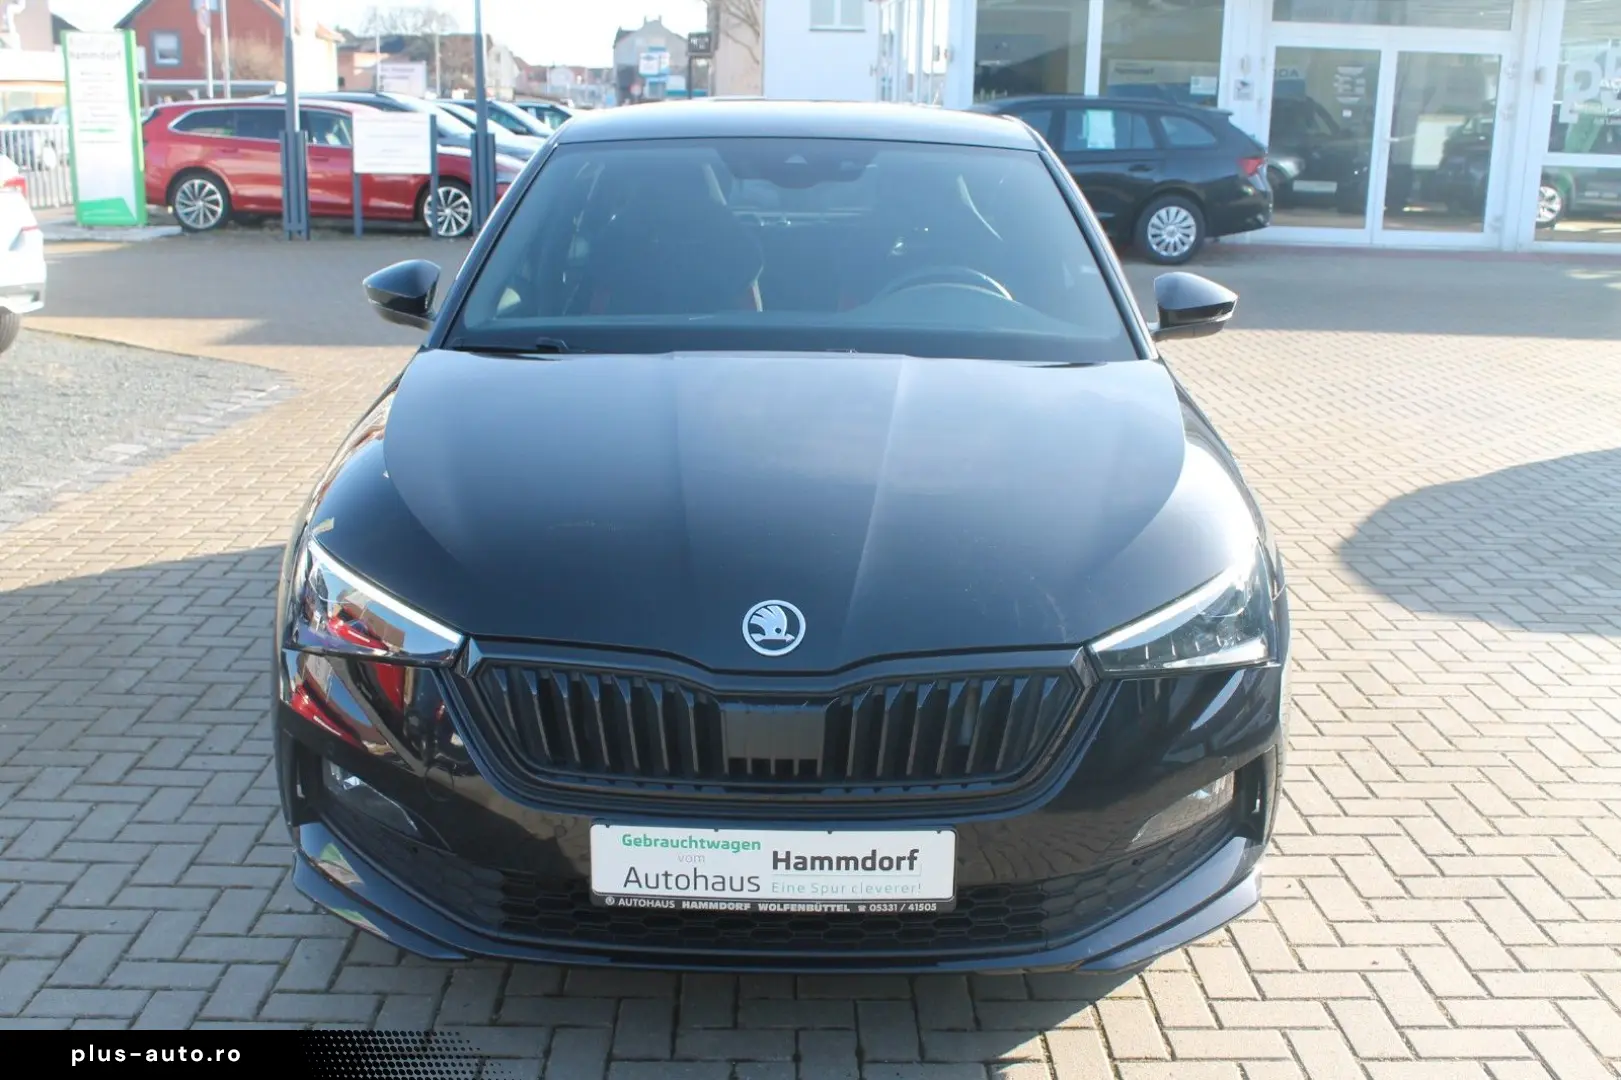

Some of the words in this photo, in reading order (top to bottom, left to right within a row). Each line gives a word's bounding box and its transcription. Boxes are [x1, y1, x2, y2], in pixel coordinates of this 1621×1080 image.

[621, 833, 762, 853] Gebrauchtwagen
[677, 853, 705, 863] vom
[772, 848, 920, 871] Hammdorf
[623, 866, 761, 892] Autohaus
[771, 881, 806, 893] Eine
[811, 882, 845, 896] Spur
[851, 881, 921, 894] cleverer!
[618, 897, 675, 908] AUTOHAUS
[682, 901, 751, 912] HAMMDORF
[758, 901, 850, 912] WOLFENBÜTTEL
[869, 903, 898, 912] 05331
[908, 903, 937, 912] 41505
